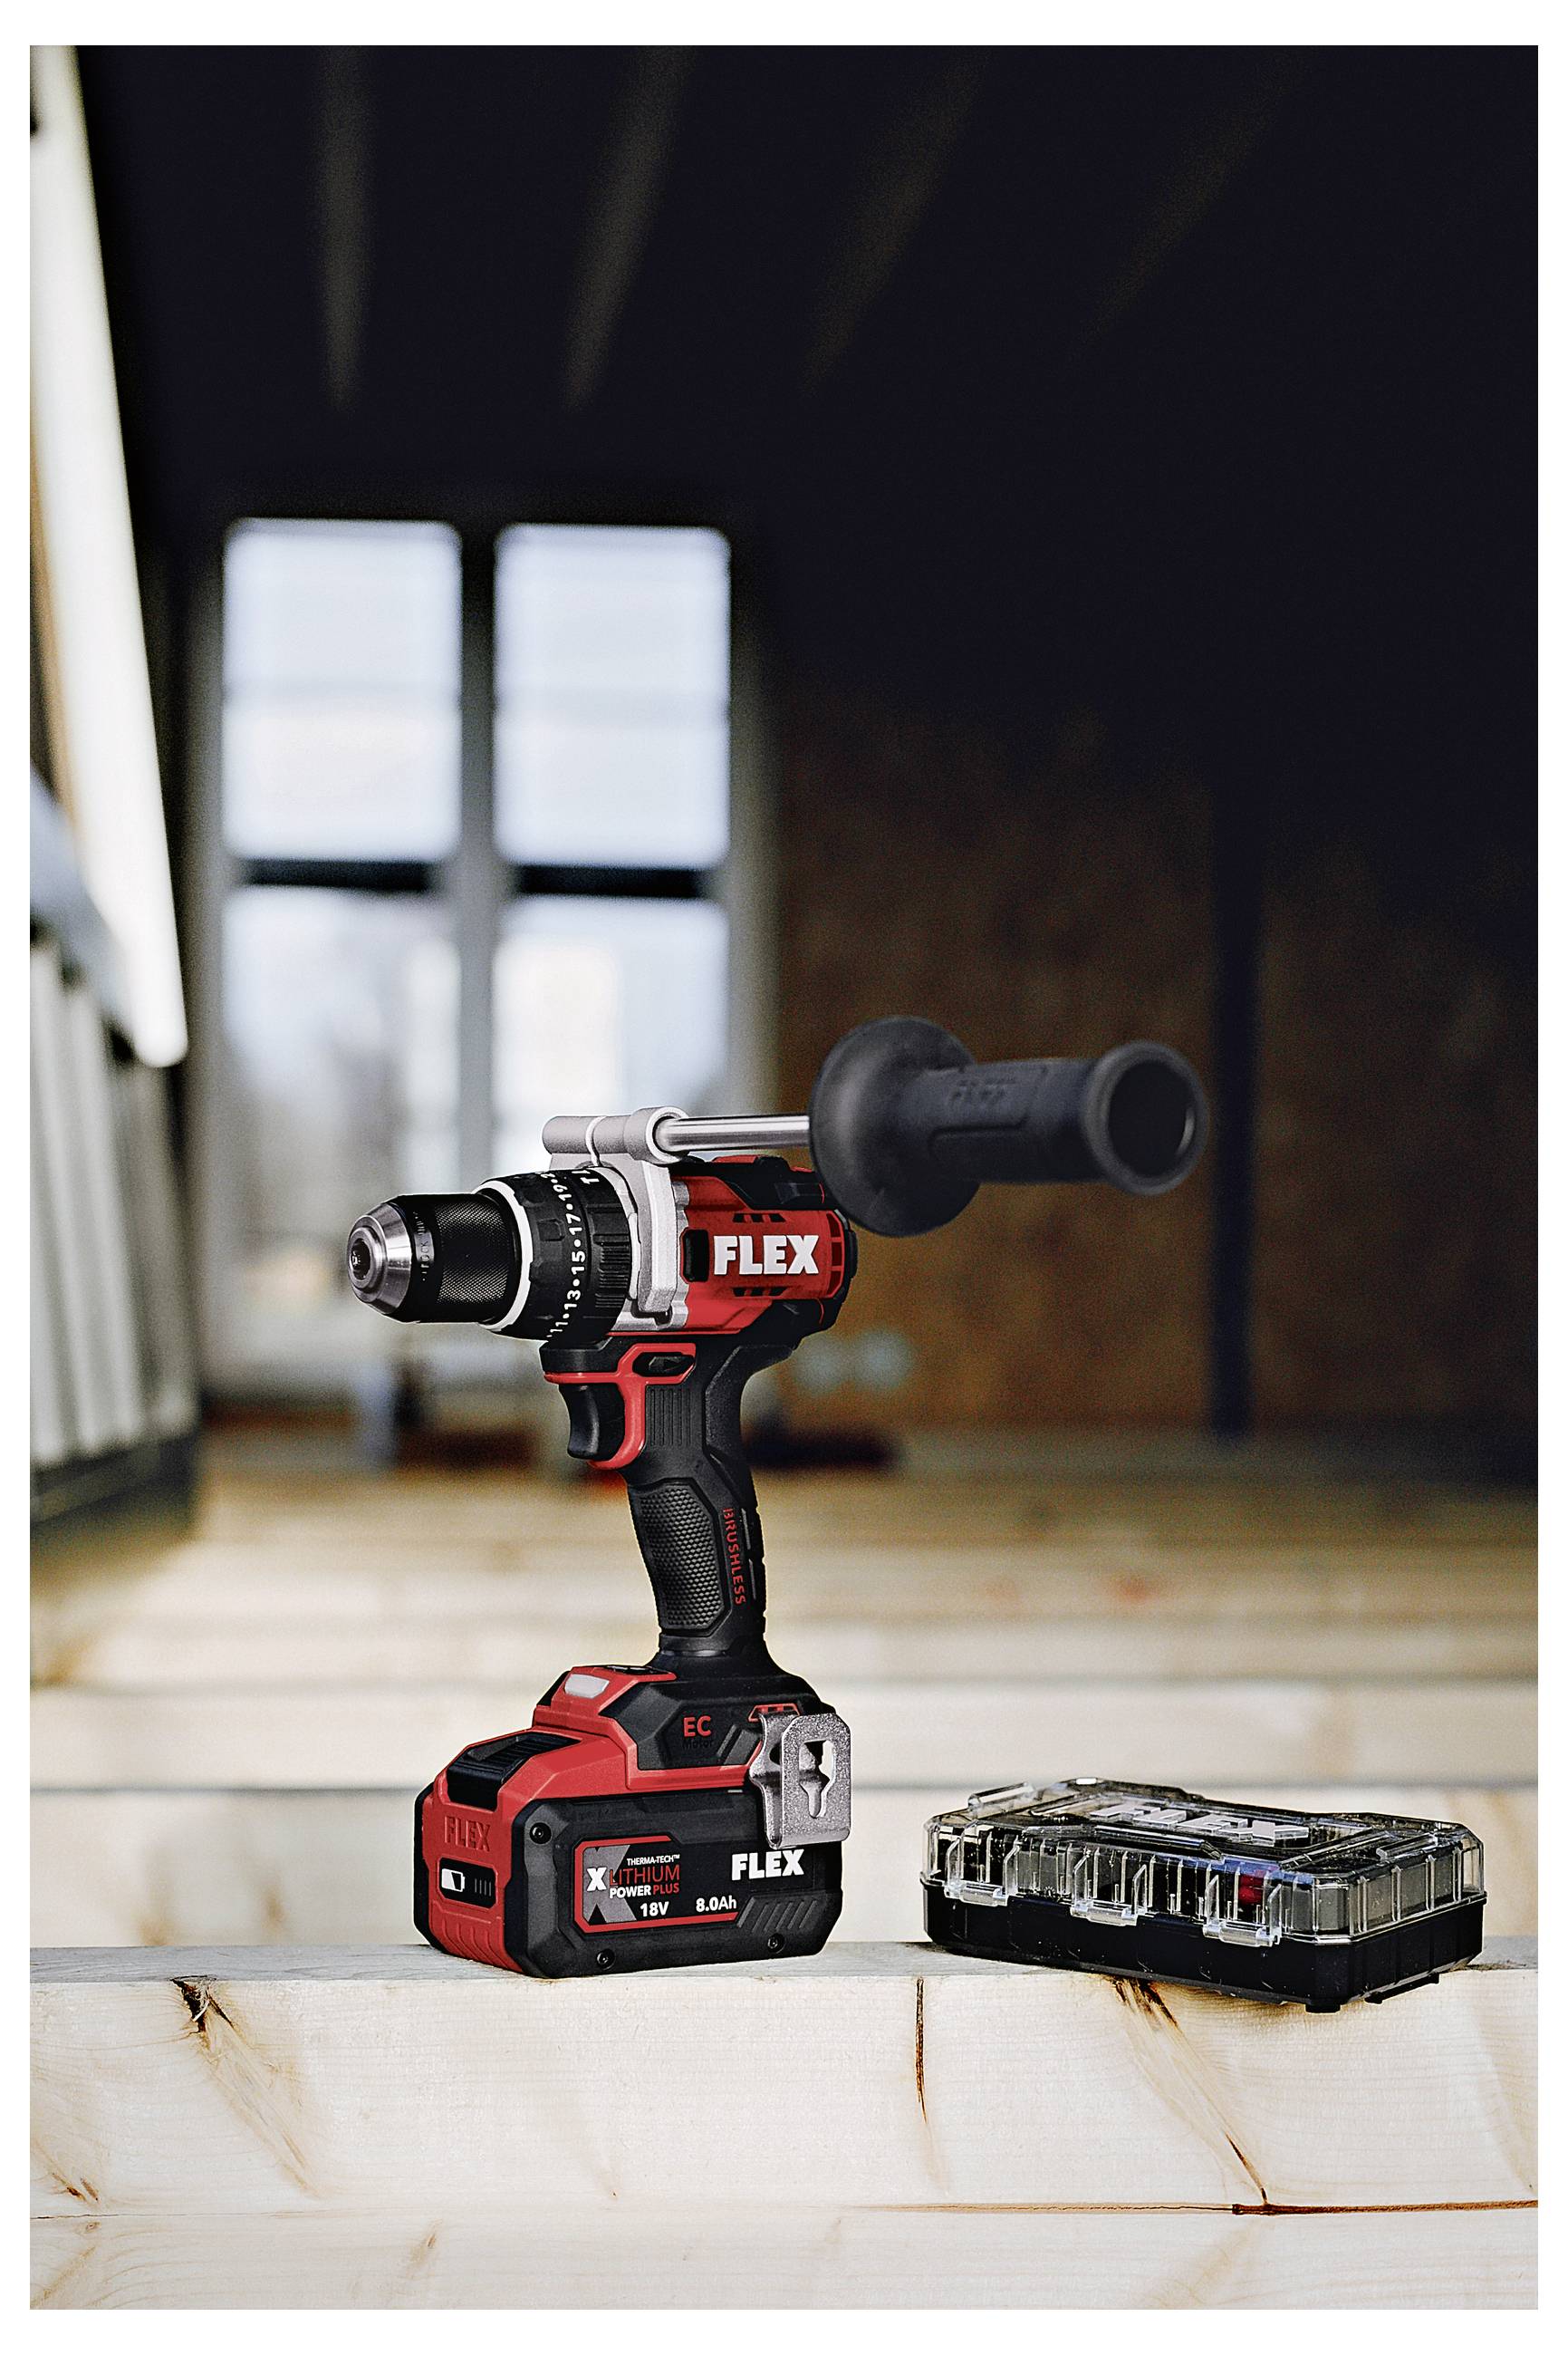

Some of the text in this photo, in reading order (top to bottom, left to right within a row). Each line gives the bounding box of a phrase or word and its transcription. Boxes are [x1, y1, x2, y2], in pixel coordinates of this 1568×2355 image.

[553, 1183, 572, 1202] 19
[565, 1212, 583, 1236] 17
[571, 1250, 586, 1275] 15
[713, 1234, 820, 1276] FLEX
[563, 1289, 582, 1309] 13
[723, 1507, 747, 1605] BRUSHLESS
[683, 1715, 712, 1738] EC
[443, 1815, 491, 1852] FLEX
[609, 1864, 680, 1887] LITHIUM
[731, 1848, 805, 1881] FLEX
[609, 1882, 680, 1899] POWER PLUS
[640, 1895, 737, 1917] 18V 8.0Ah
